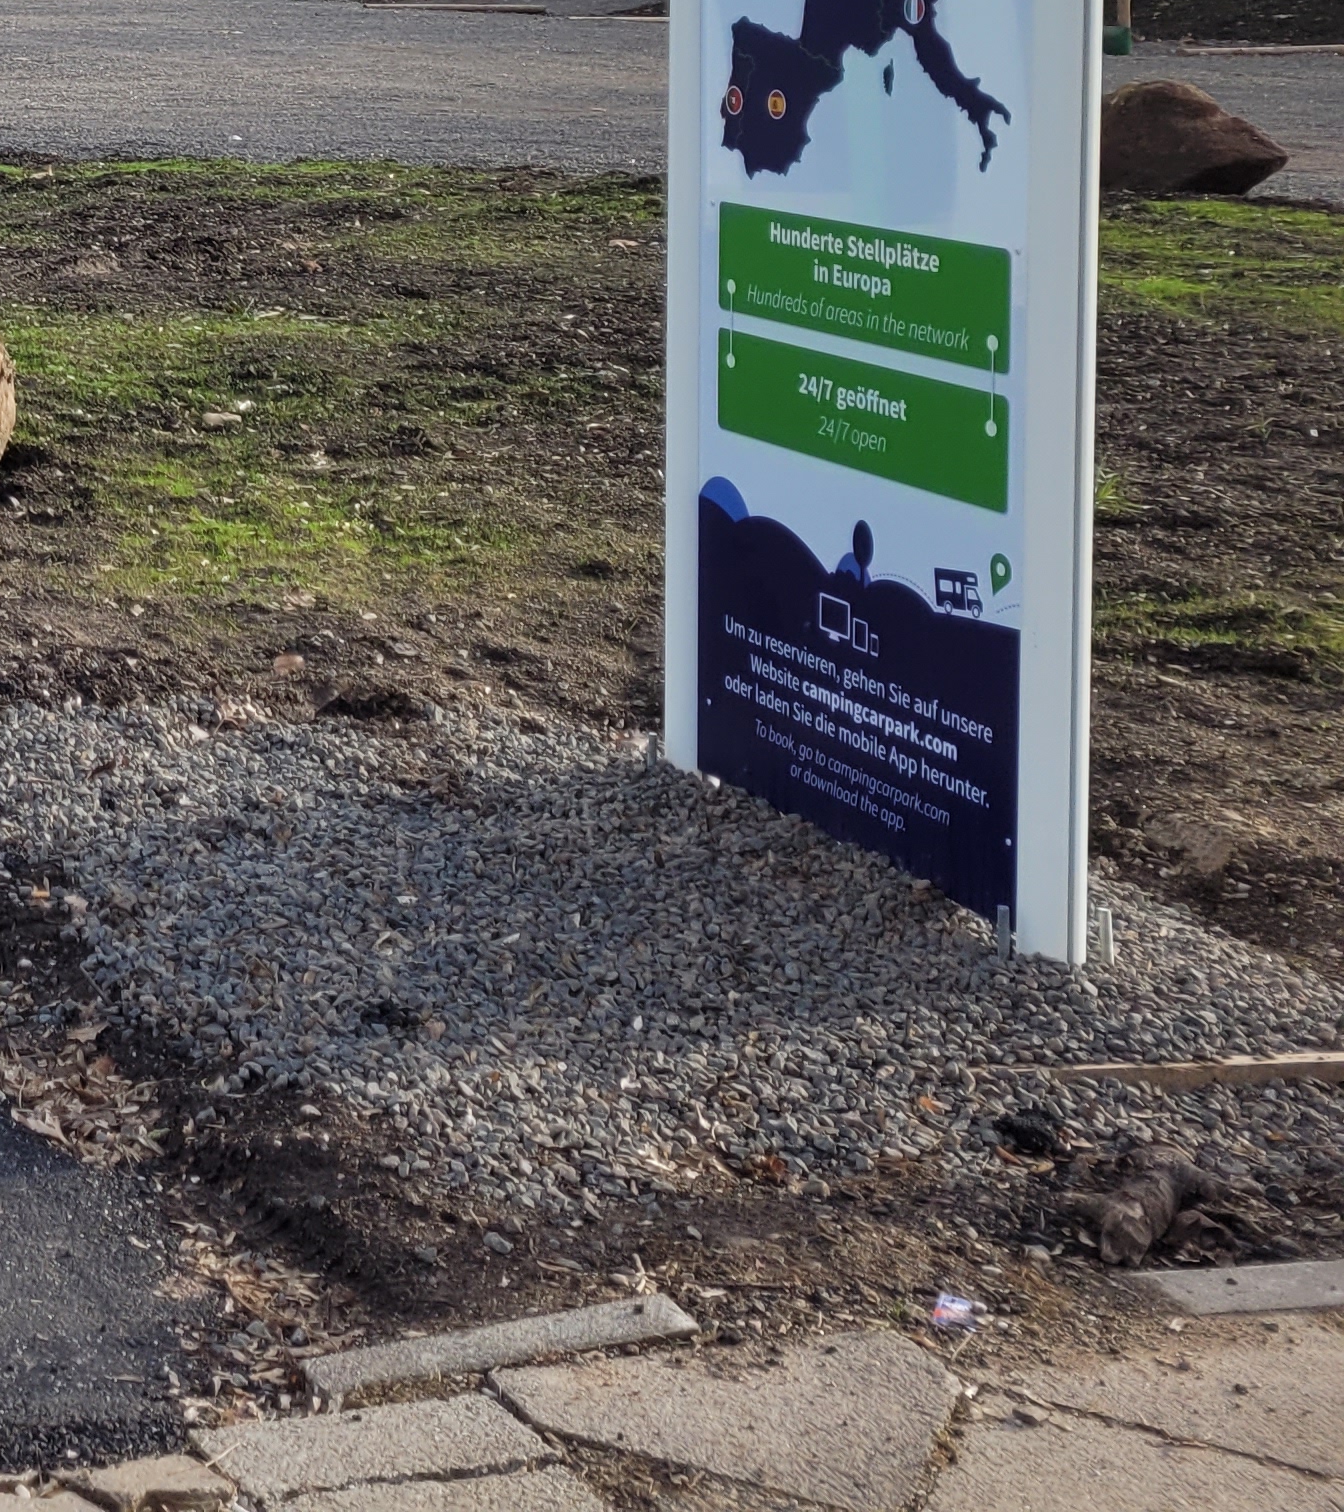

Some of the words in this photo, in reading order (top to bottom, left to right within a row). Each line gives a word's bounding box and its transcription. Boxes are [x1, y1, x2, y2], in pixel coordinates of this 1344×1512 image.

[769, 221, 843, 255] Hunderte
[847, 235, 939, 273] Stellplätze
[813, 258, 828, 283] in
[833, 263, 891, 298] Europa
[747, 284, 807, 315] Hundreds
[810, 297, 825, 318] of
[826, 304, 863, 327] areas
[866, 309, 879, 330] in
[883, 313, 905, 337] the
[908, 321, 969, 351] network
[798, 372, 833, 402] 24/7
[836, 386, 907, 421] geöffnet
[818, 416, 849, 444] 24/7
[851, 429, 886, 452] open
[725, 614, 746, 640] Um
[748, 628, 762, 647] zu
[765, 635, 840, 684] reservieren,
[843, 668, 886, 699] gehen
[889, 683, 911, 709] Sie
[914, 697, 939, 721] auf
[941, 708, 993, 744] unsere
[750, 653, 800, 692] Website
[802, 680, 958, 762] campingcarpark.com
[724, 675, 753, 700] oder
[755, 682, 790, 718] laden
[792, 702, 813, 727] Sie
[815, 711, 836, 737] die
[839, 726, 886, 761] mobile
[889, 745, 918, 779] App
[921, 757, 990, 808] herunter.
[755, 718, 767, 738] To
[768, 725, 797, 756] book,
[798, 744, 813, 762] go
[815, 749, 826, 766] to
[827, 758, 950, 826] campingcarpark.com
[790, 764, 802, 779] or
[803, 768, 859, 807] download
[860, 795, 879, 817] the
[880, 808, 906, 832] app.
